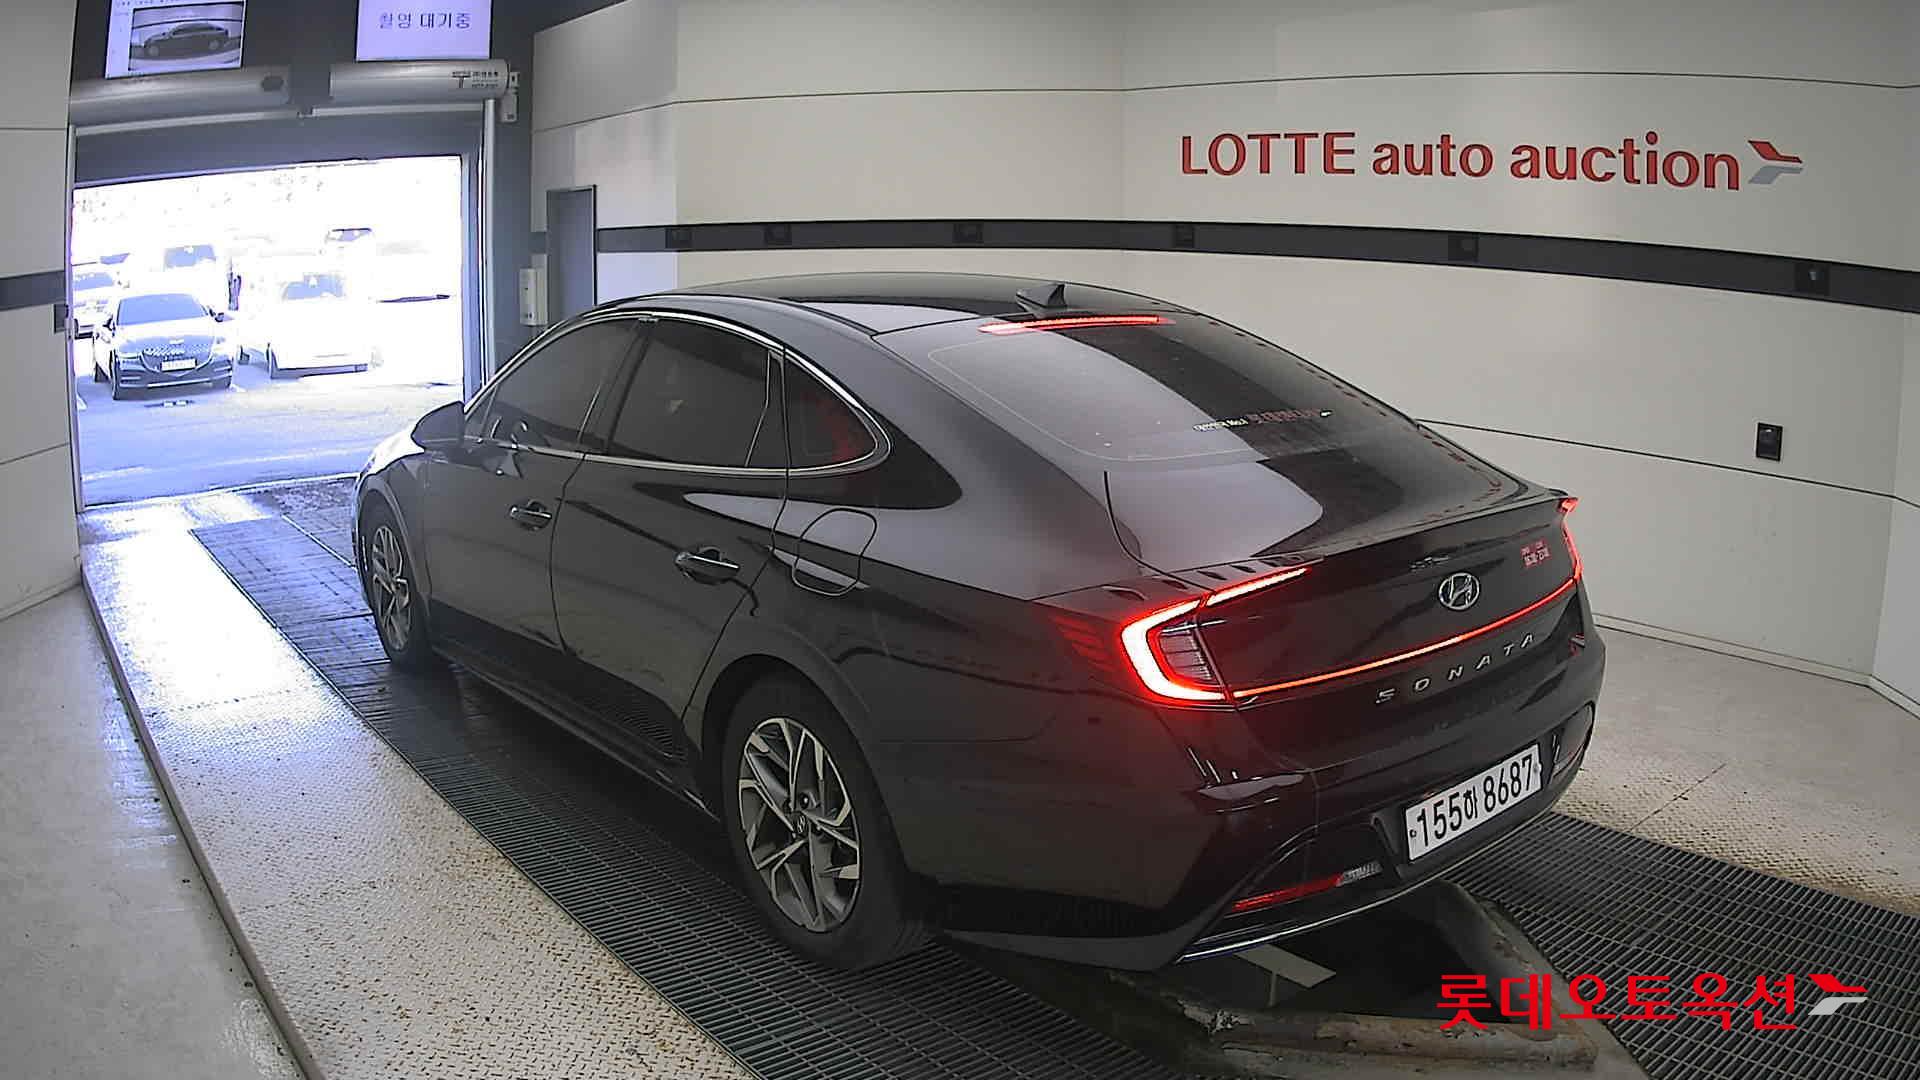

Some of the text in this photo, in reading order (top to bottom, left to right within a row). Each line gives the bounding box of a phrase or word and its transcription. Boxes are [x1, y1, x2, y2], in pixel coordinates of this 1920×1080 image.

[420, 12, 471, 29] 대기중
[1181, 130, 1741, 191] LOTTE auto auction
[1375, 633, 1536, 704] SONATA
[1416, 753, 1534, 847] 155하 8687
